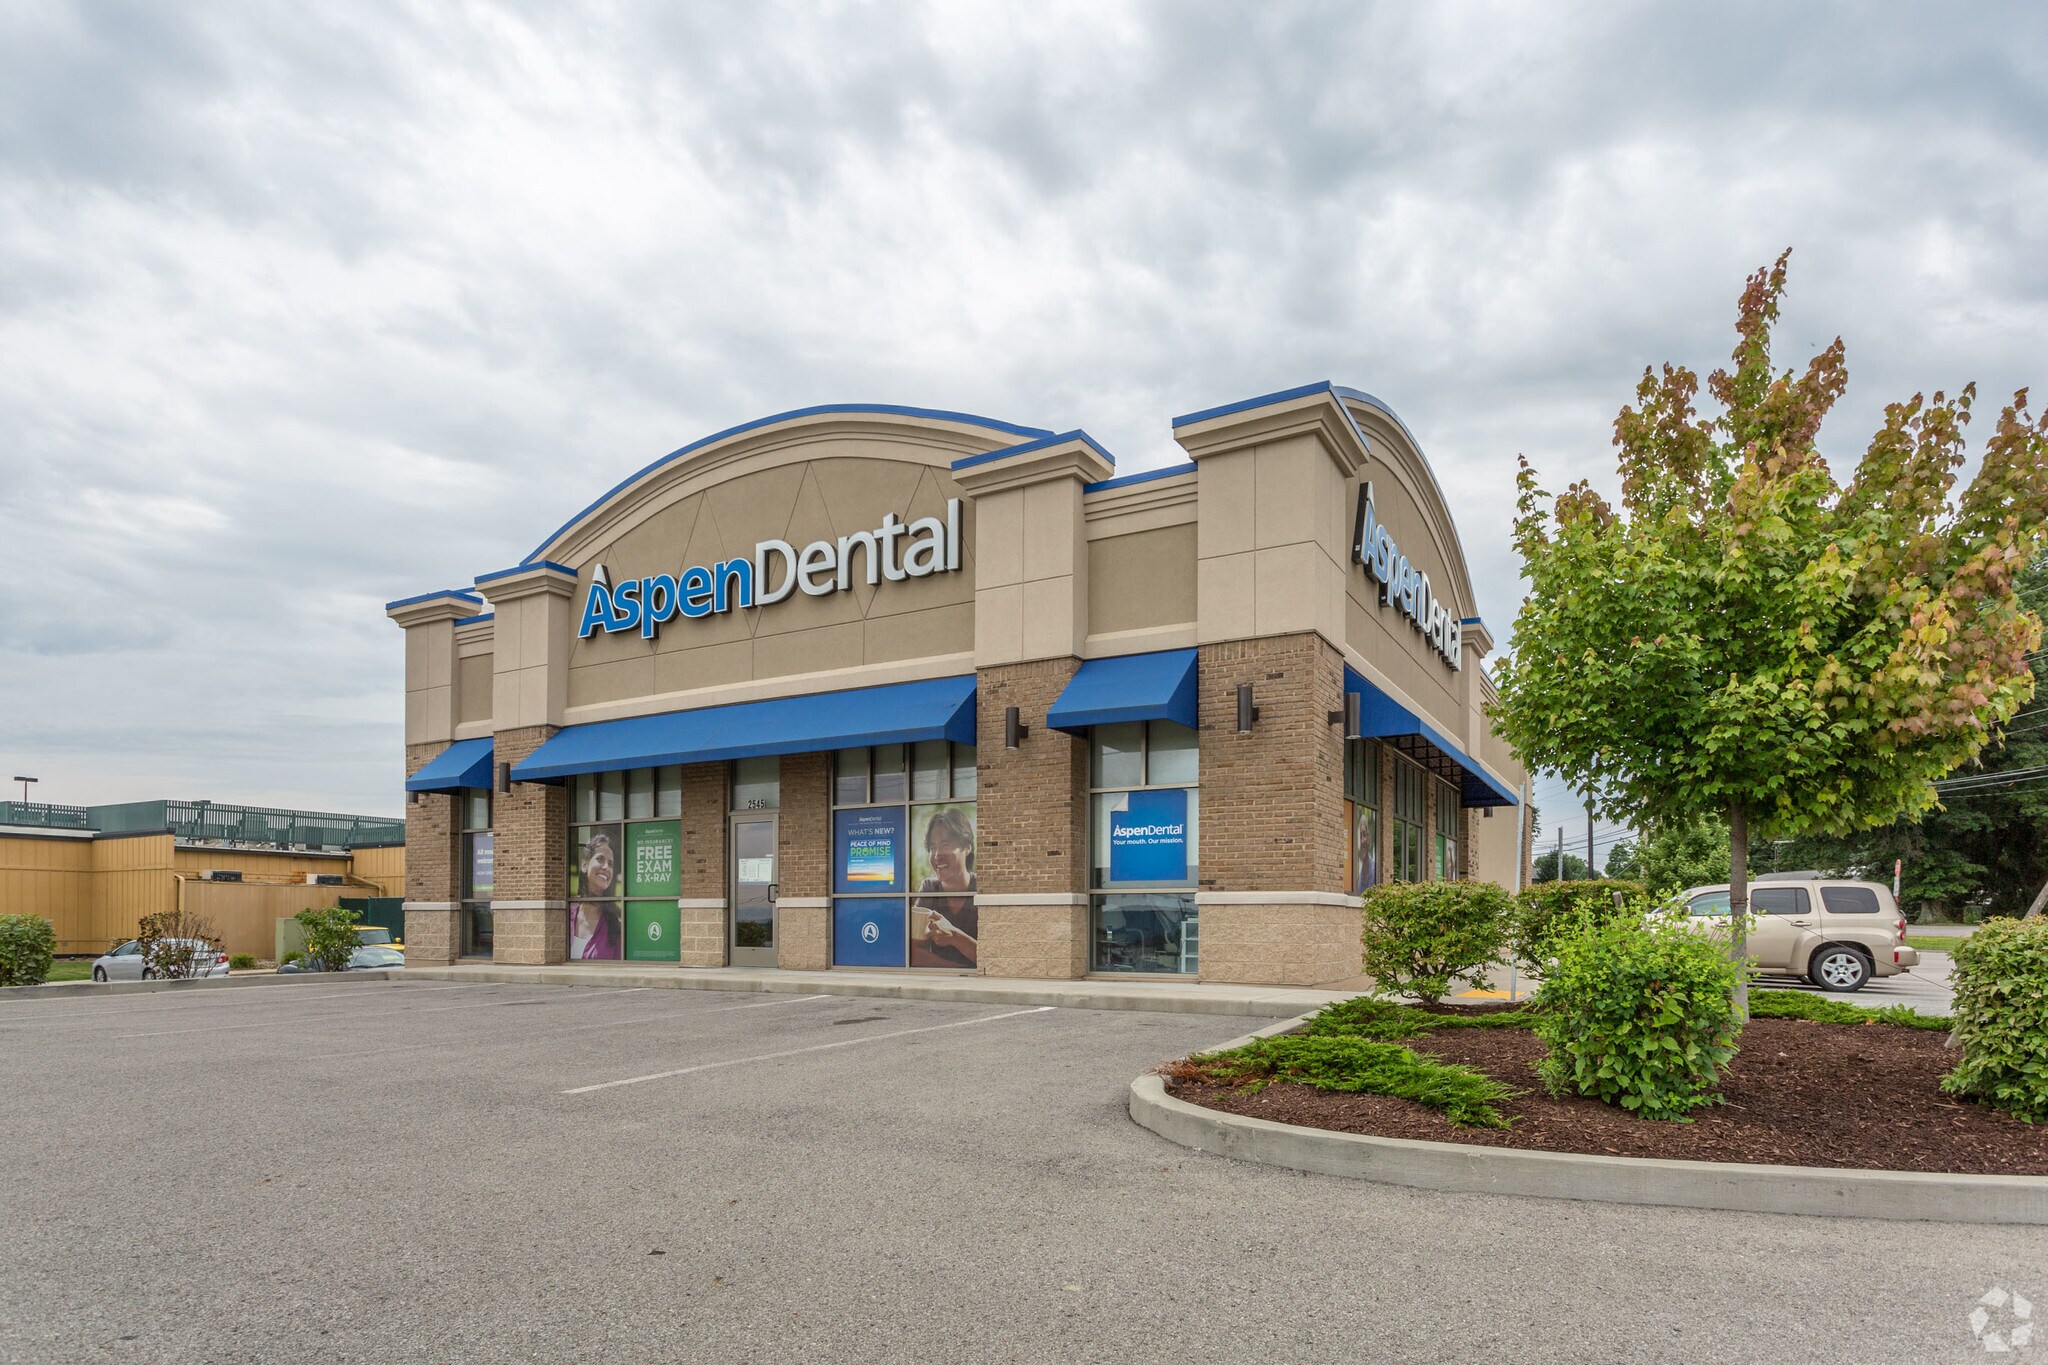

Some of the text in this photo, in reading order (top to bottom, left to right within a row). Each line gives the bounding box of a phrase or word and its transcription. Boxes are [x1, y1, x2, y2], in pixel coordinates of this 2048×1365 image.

[578, 498, 962, 639] AspenDental
[1356, 481, 1461, 671] AspenDental
[748, 799, 765, 809] 2545
[1113, 824, 1183, 838] AspenDental
[637, 846, 672, 860] FREE
[850, 846, 891, 857] PROMISE
[637, 860, 672, 873] EXAM
[637, 873, 671, 882] & X-RAY
